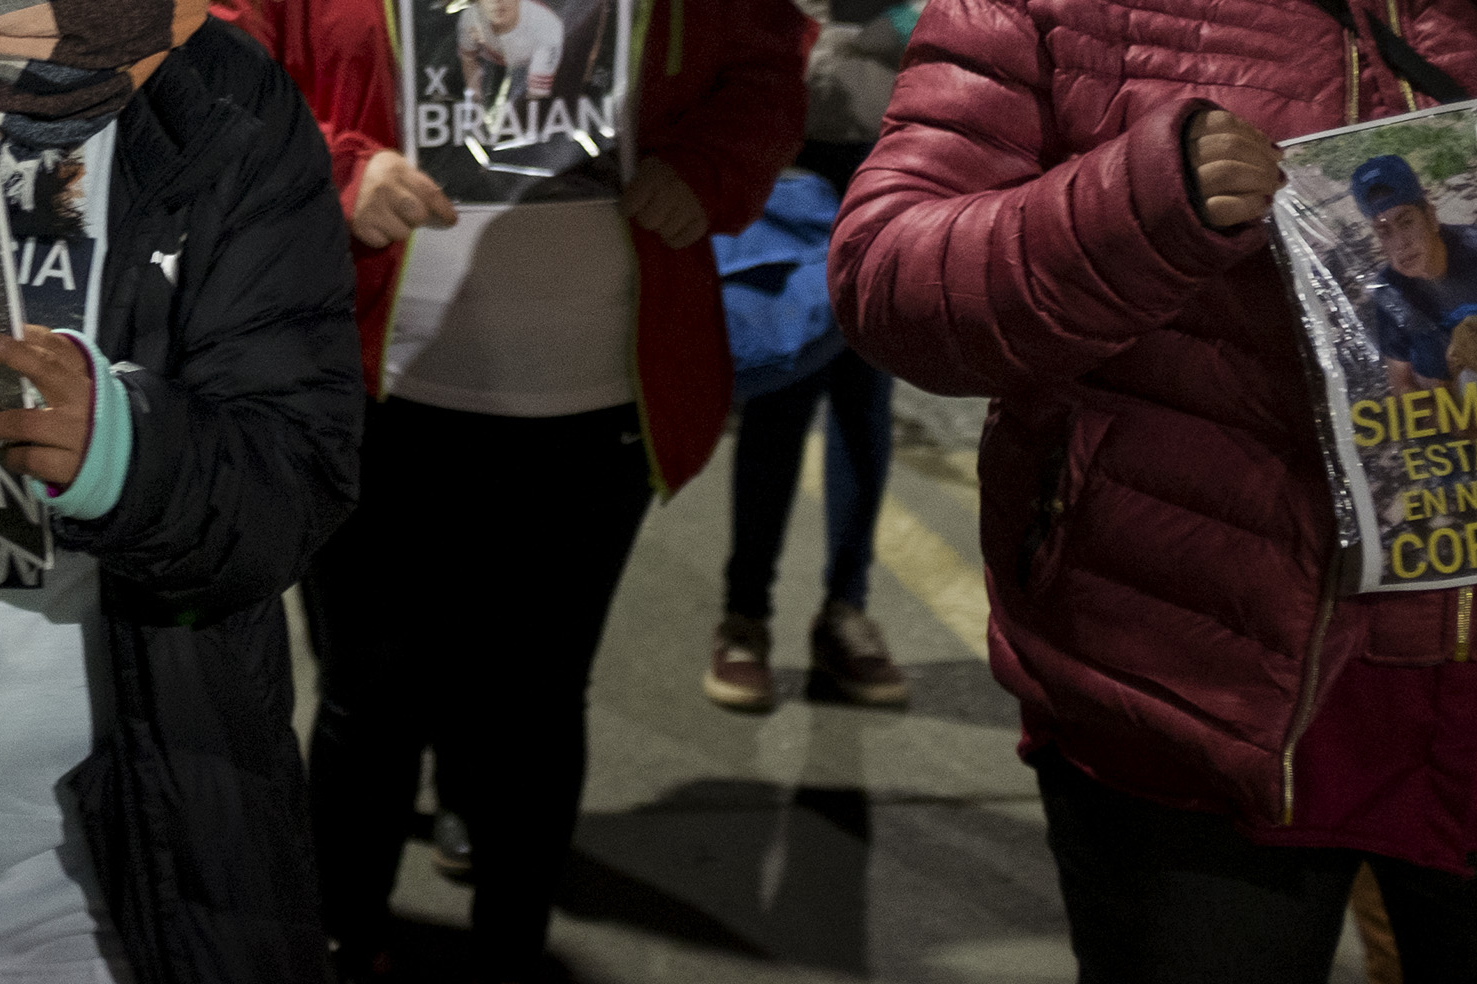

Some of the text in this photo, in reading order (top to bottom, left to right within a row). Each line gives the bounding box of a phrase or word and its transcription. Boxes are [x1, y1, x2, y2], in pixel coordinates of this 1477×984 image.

[417, 96, 614, 149] BRAIAN
[8, 236, 76, 291] IA
[1401, 438, 1477, 481] EST
[1402, 486, 1448, 521] EN
